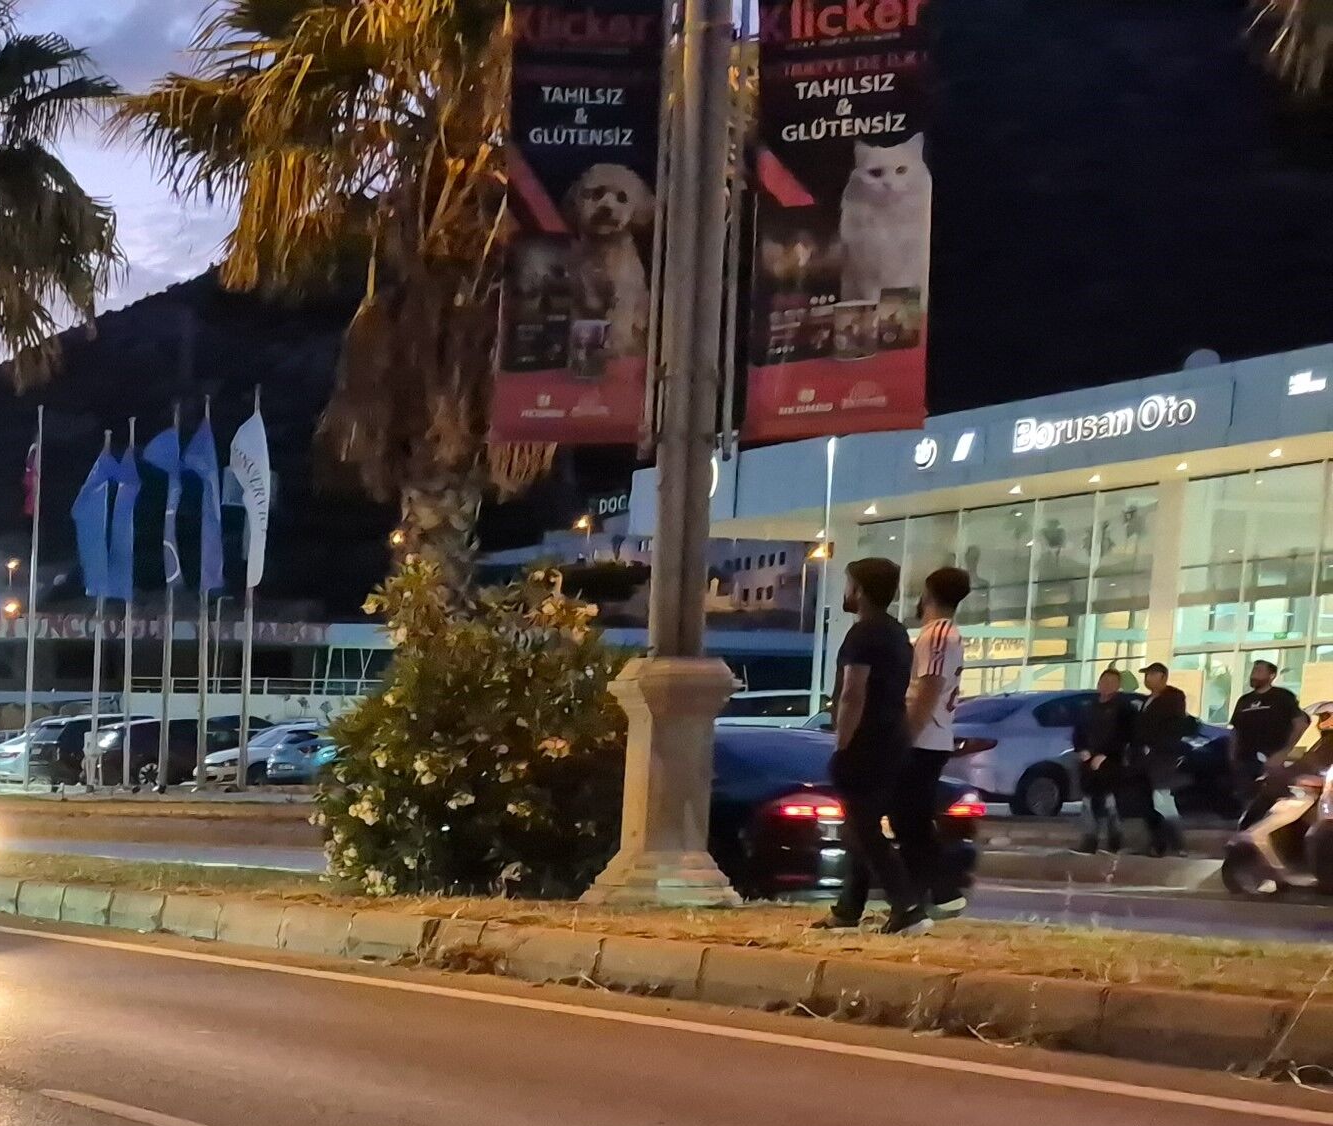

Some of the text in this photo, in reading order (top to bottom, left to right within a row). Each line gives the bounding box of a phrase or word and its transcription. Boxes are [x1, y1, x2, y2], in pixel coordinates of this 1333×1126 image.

[541, 86, 625, 105] TAHILSIZ
[794, 73, 895, 100] TAHILSIZ
[574, 107, 588, 125] &
[835, 98, 853, 116] &
[528, 125, 634, 146] GLÜTENSİZ
[781, 111, 907, 142] GLÜTENSİZ
[1012, 395, 1197, 453] Borusan Oto
